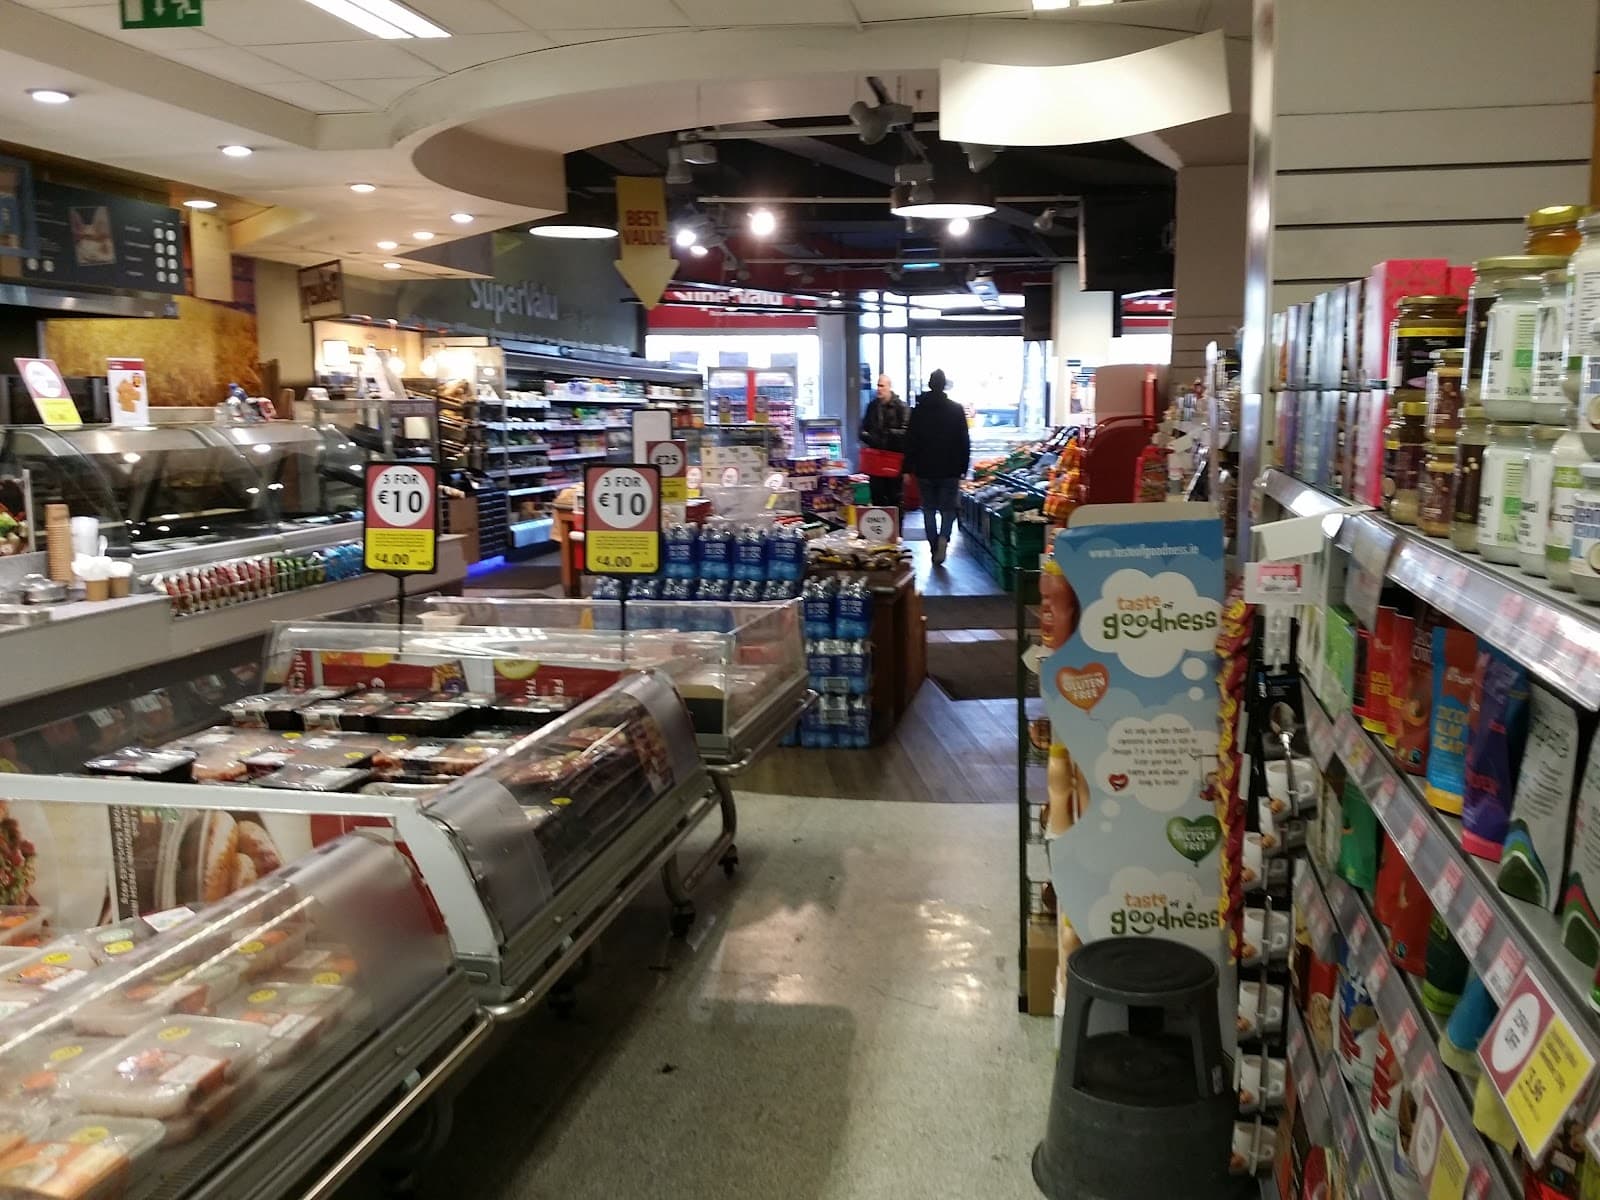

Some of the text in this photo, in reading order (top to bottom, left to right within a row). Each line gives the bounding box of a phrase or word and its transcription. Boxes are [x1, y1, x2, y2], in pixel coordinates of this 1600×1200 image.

[626, 210, 659, 226] BEST
[624, 230, 667, 245] VALUE
[471, 279, 558, 324] SuperValu
[393, 474, 420, 485] FOR
[614, 476, 641, 487] FOR
[378, 490, 423, 513] €10
[598, 492, 646, 516] €10
[1116, 594, 1161, 611] taste
[1103, 608, 1218, 640] goodness
[1124, 893, 1167, 908] taste
[1111, 906, 1220, 935] goodness
